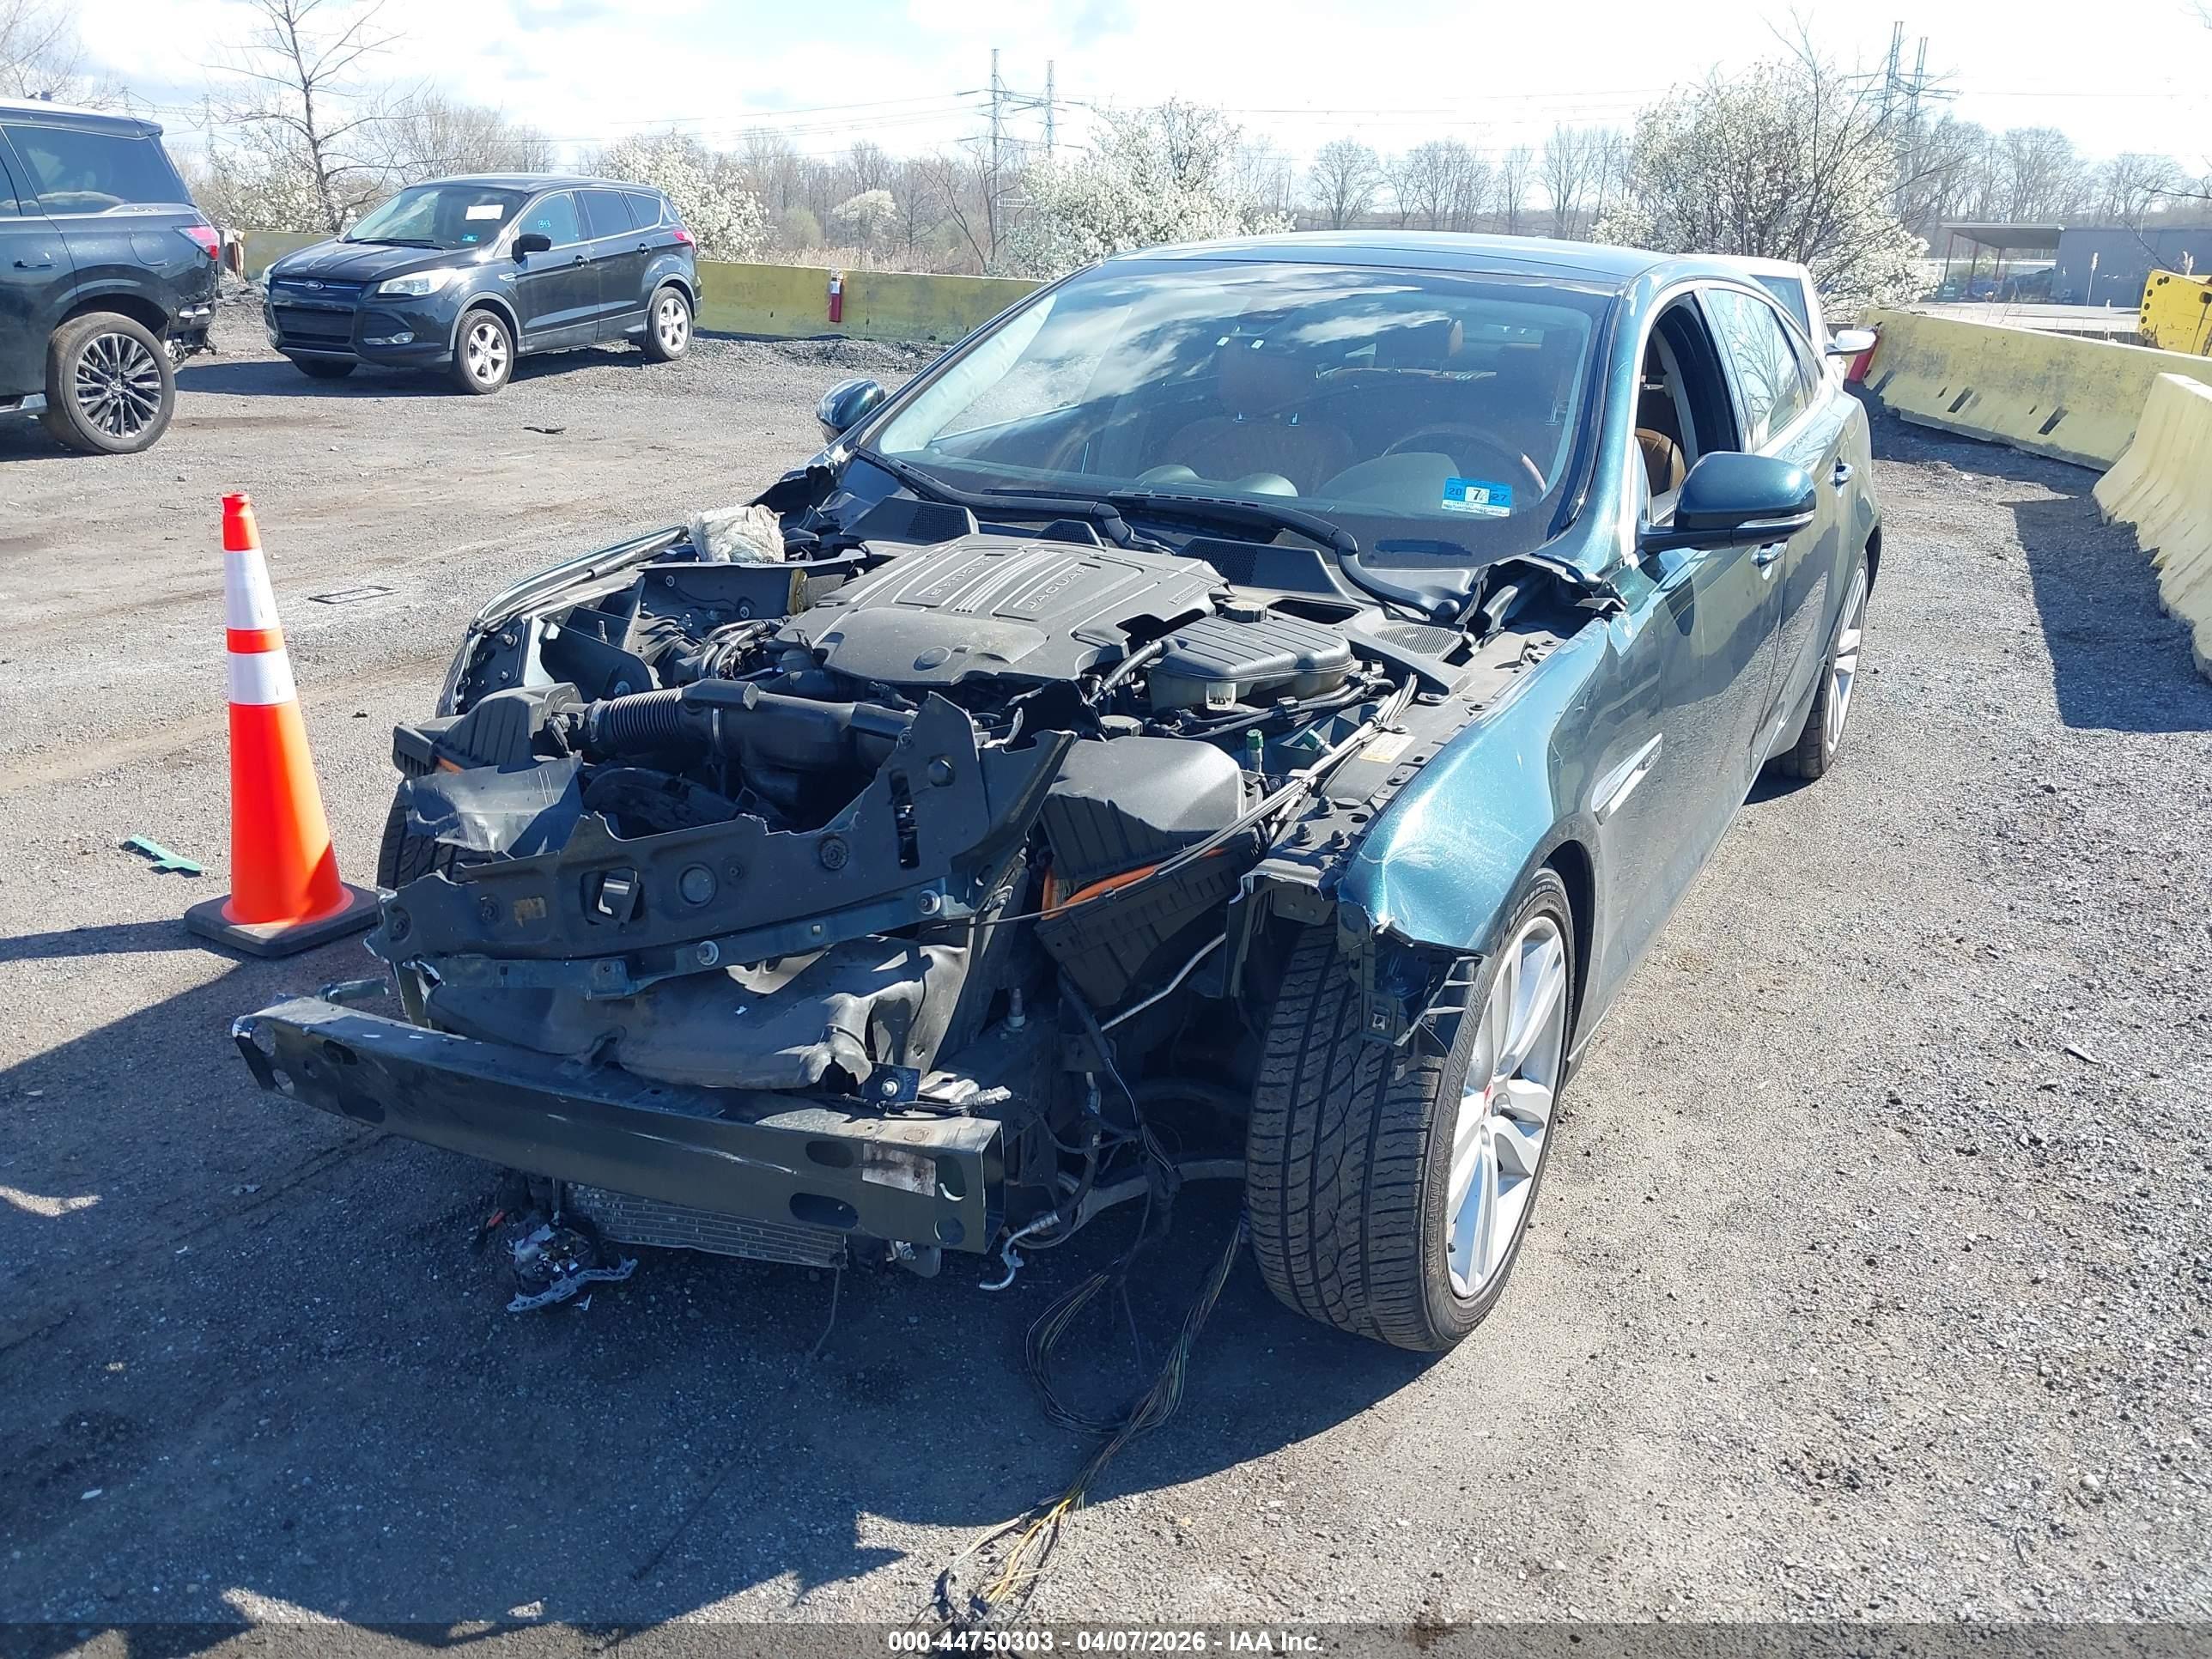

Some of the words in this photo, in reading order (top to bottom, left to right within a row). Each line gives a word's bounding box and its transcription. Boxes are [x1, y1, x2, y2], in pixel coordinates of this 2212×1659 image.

[1449, 487, 1462, 496] 20
[1473, 489, 1481, 501] 7
[1491, 493, 1507, 501] 27
[1028, 565, 1090, 611] JAGUAR
[1442, 969, 1489, 1117] TOURING
